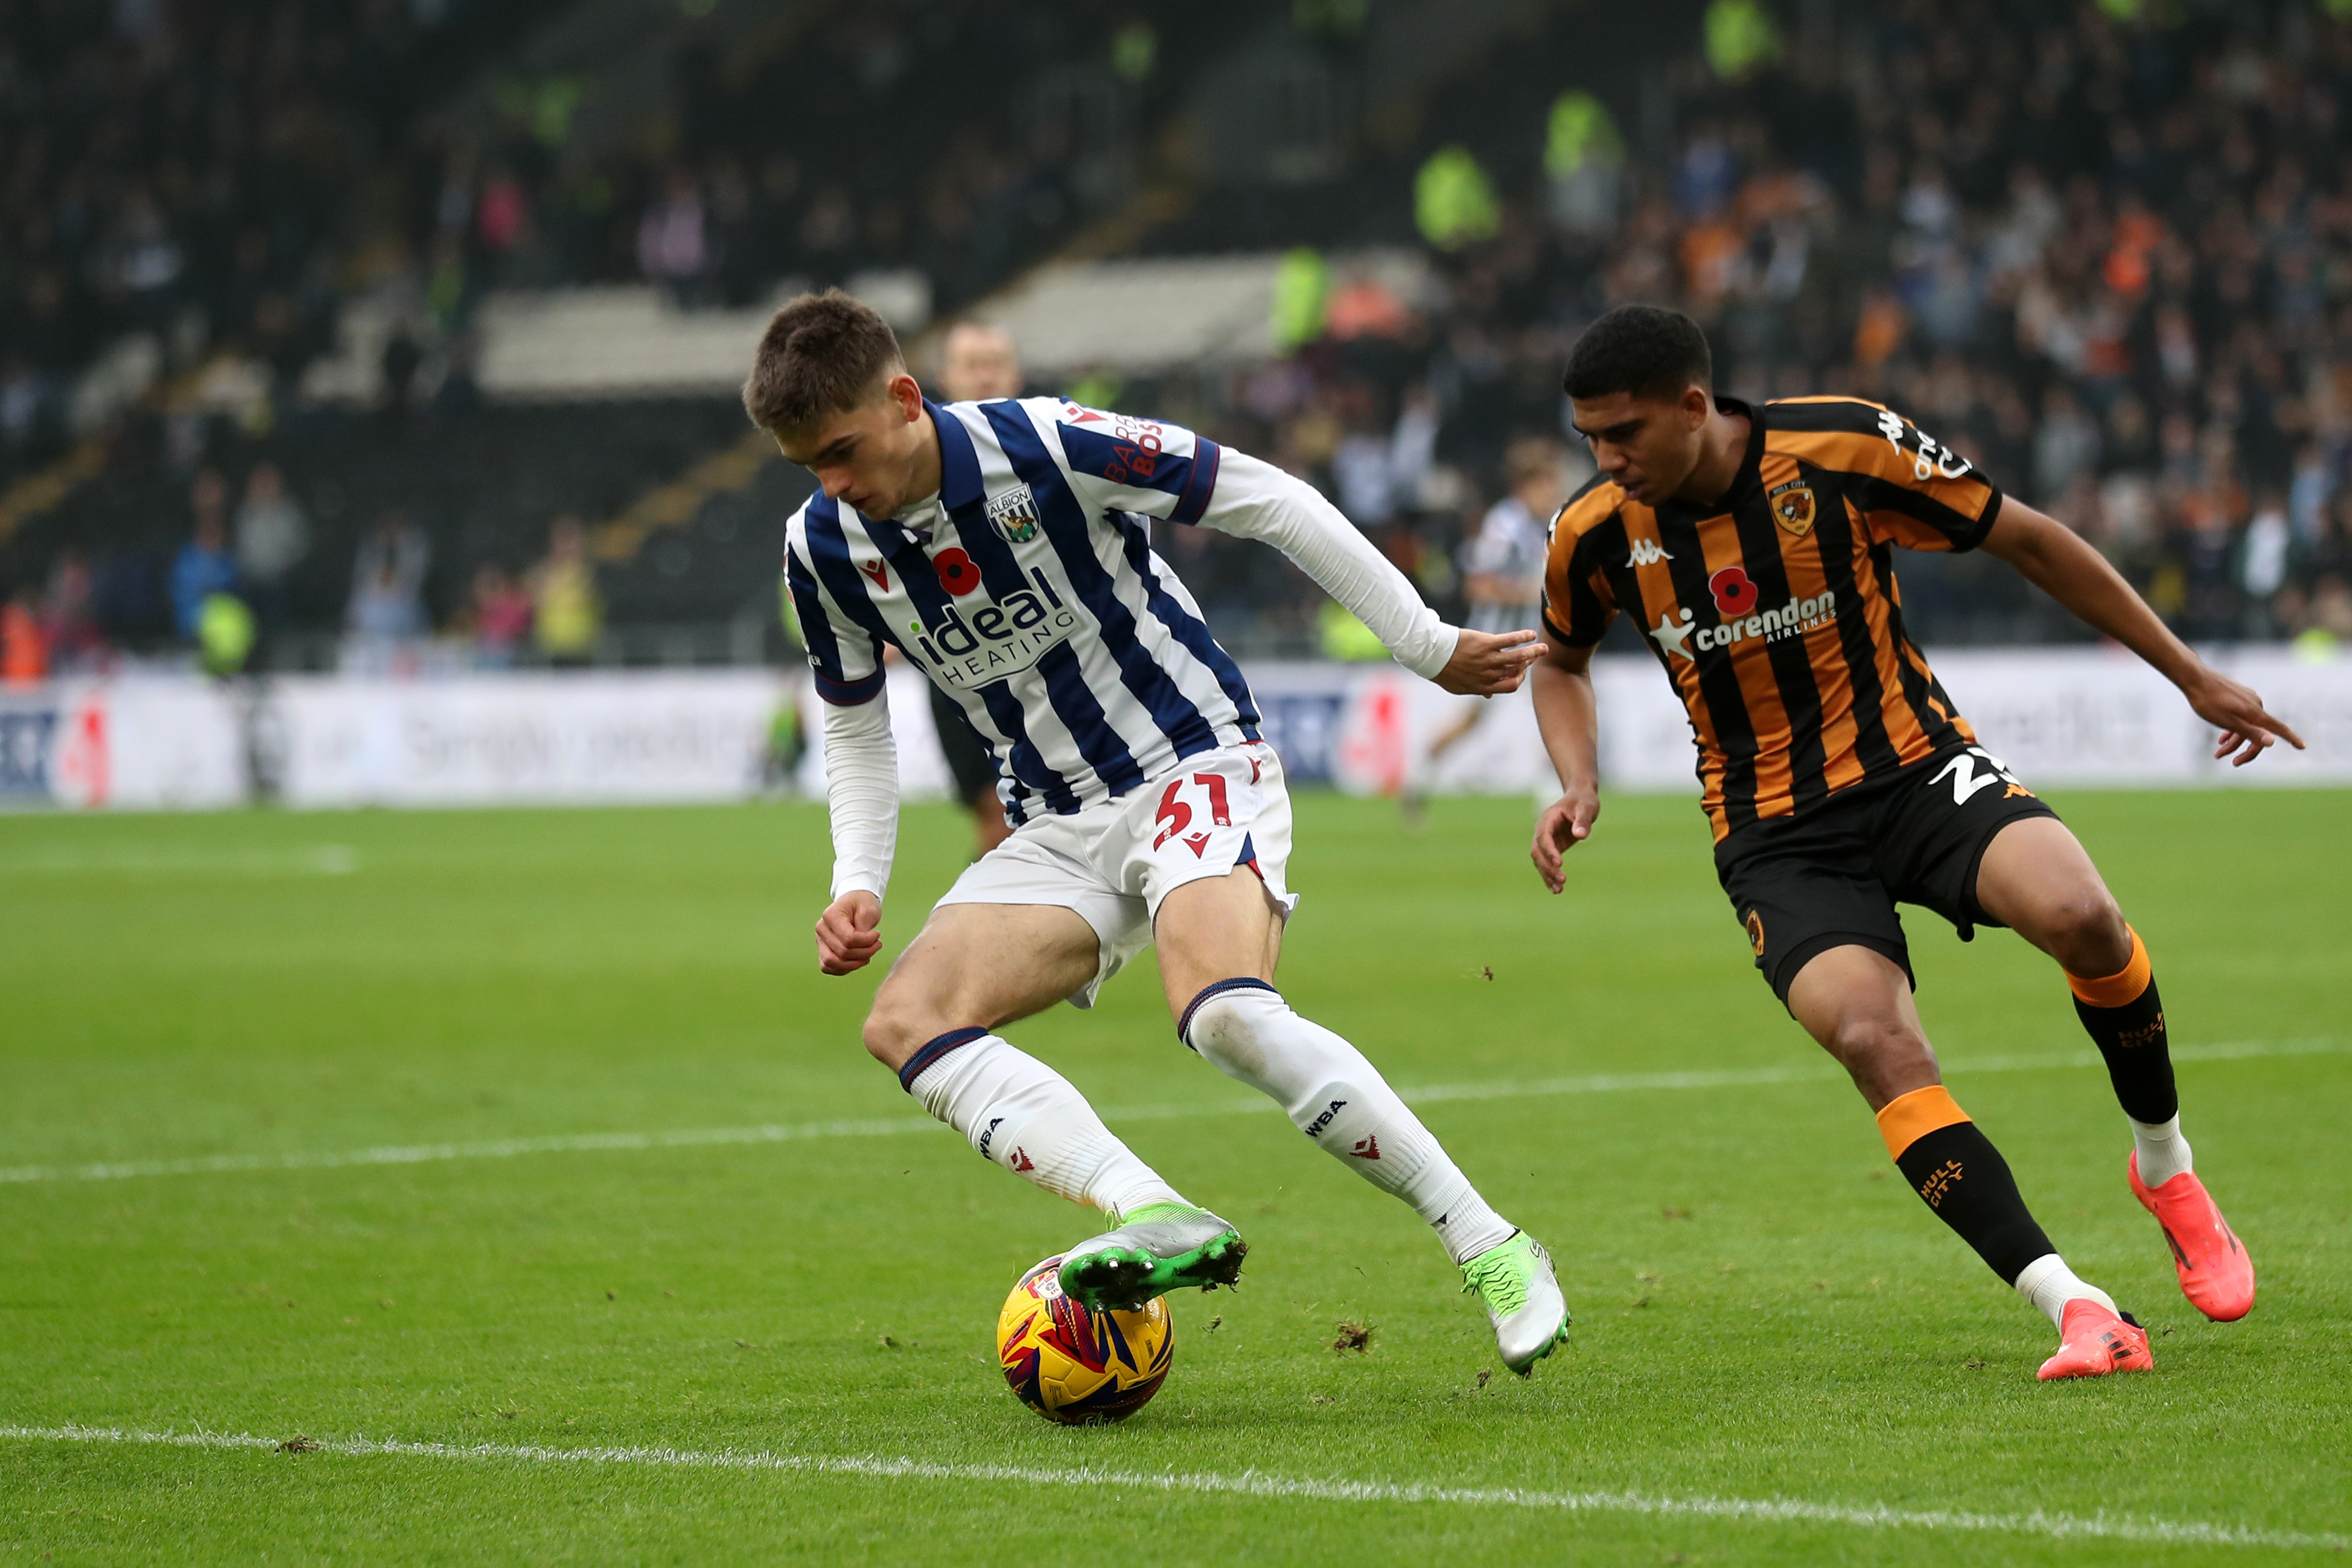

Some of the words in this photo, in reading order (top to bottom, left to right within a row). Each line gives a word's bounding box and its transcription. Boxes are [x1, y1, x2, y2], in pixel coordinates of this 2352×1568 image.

[990, 491, 1028, 516] ALBION
[910, 566, 1063, 666] ideal
[1695, 590, 1836, 652] corendon
[1766, 608, 1837, 644] AIRLINES
[942, 611, 1074, 685] HEATING
[979, 1117, 1005, 1160] WBA
[1305, 1100, 1348, 1138] WBA
[1920, 1159, 1963, 1199] HULL
[1930, 1167, 1963, 1208] CITY
